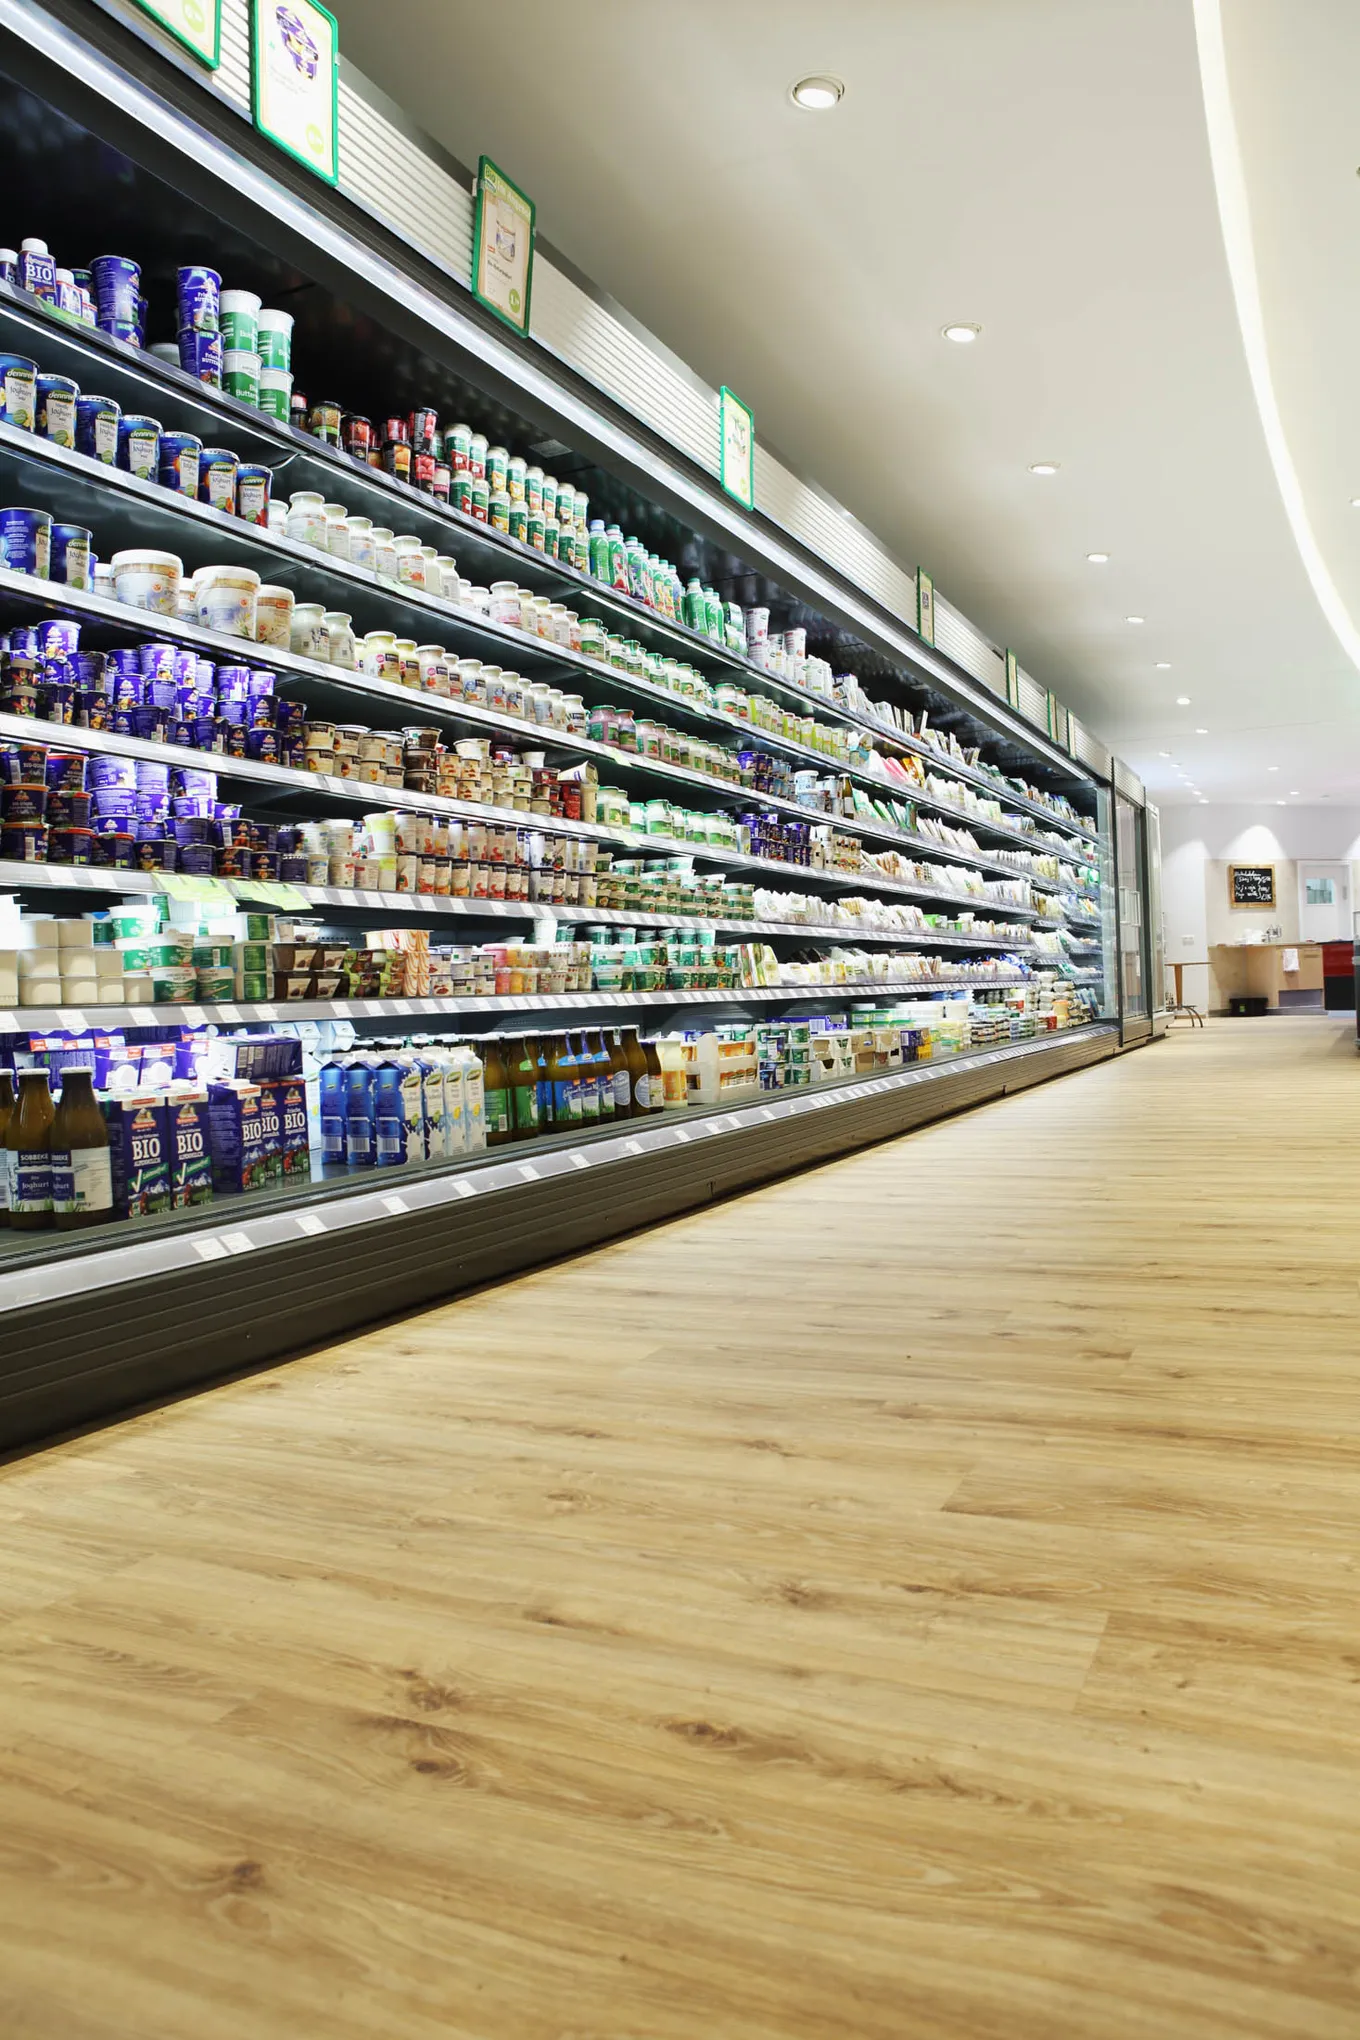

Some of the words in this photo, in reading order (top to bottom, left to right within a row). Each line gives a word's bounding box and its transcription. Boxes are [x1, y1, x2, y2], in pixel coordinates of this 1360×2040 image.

[27, 263, 52, 281] BIO
[261, 1115, 279, 1132] BIO
[283, 1112, 305, 1129] BIO
[242, 1122, 262, 1141] BIO
[131, 1137, 161, 1161] BIO
[176, 1132, 204, 1154] BIO
[22, 1181, 49, 1192] Joghurt
